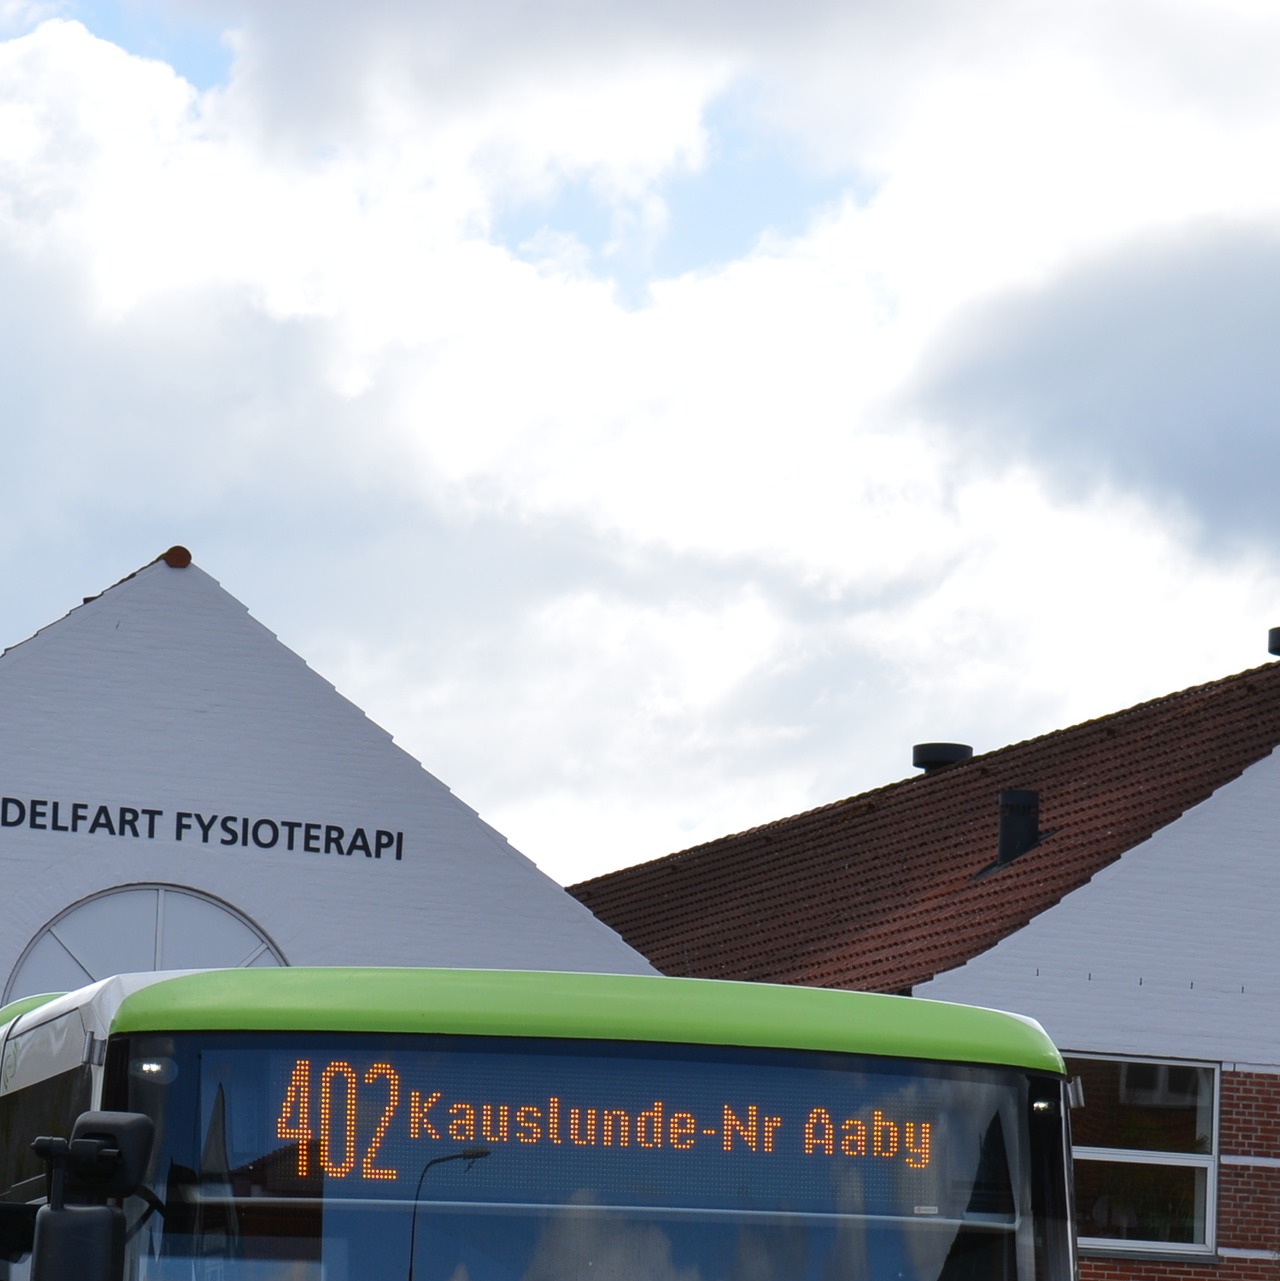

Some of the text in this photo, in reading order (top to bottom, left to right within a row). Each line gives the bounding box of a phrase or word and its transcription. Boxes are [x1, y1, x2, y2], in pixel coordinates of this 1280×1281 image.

[175, 811, 404, 861] FYSIOTERAPI
[276, 1058, 398, 1181] 402
[409, 1088, 934, 1171] Kauslunde-Nr Aaby
